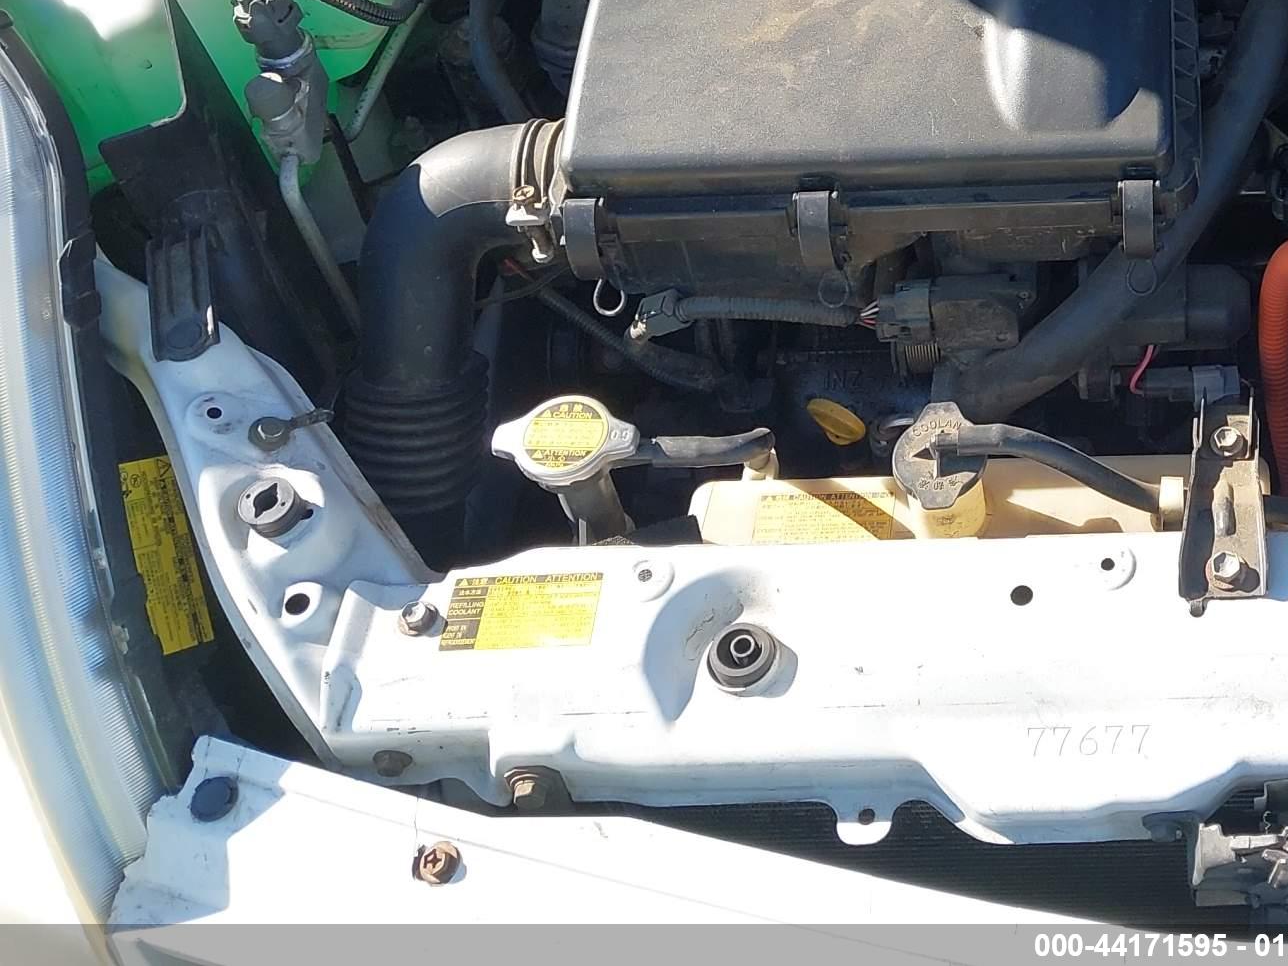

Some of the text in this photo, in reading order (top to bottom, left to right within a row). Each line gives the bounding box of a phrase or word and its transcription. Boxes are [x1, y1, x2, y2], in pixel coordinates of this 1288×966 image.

[495, 576, 537, 584] CAUTION
[545, 573, 598, 583] ATTENTION
[450, 601, 485, 609] REFILLING
[448, 608, 481, 616] COOLANT
[1027, 725, 1151, 757] 77677
